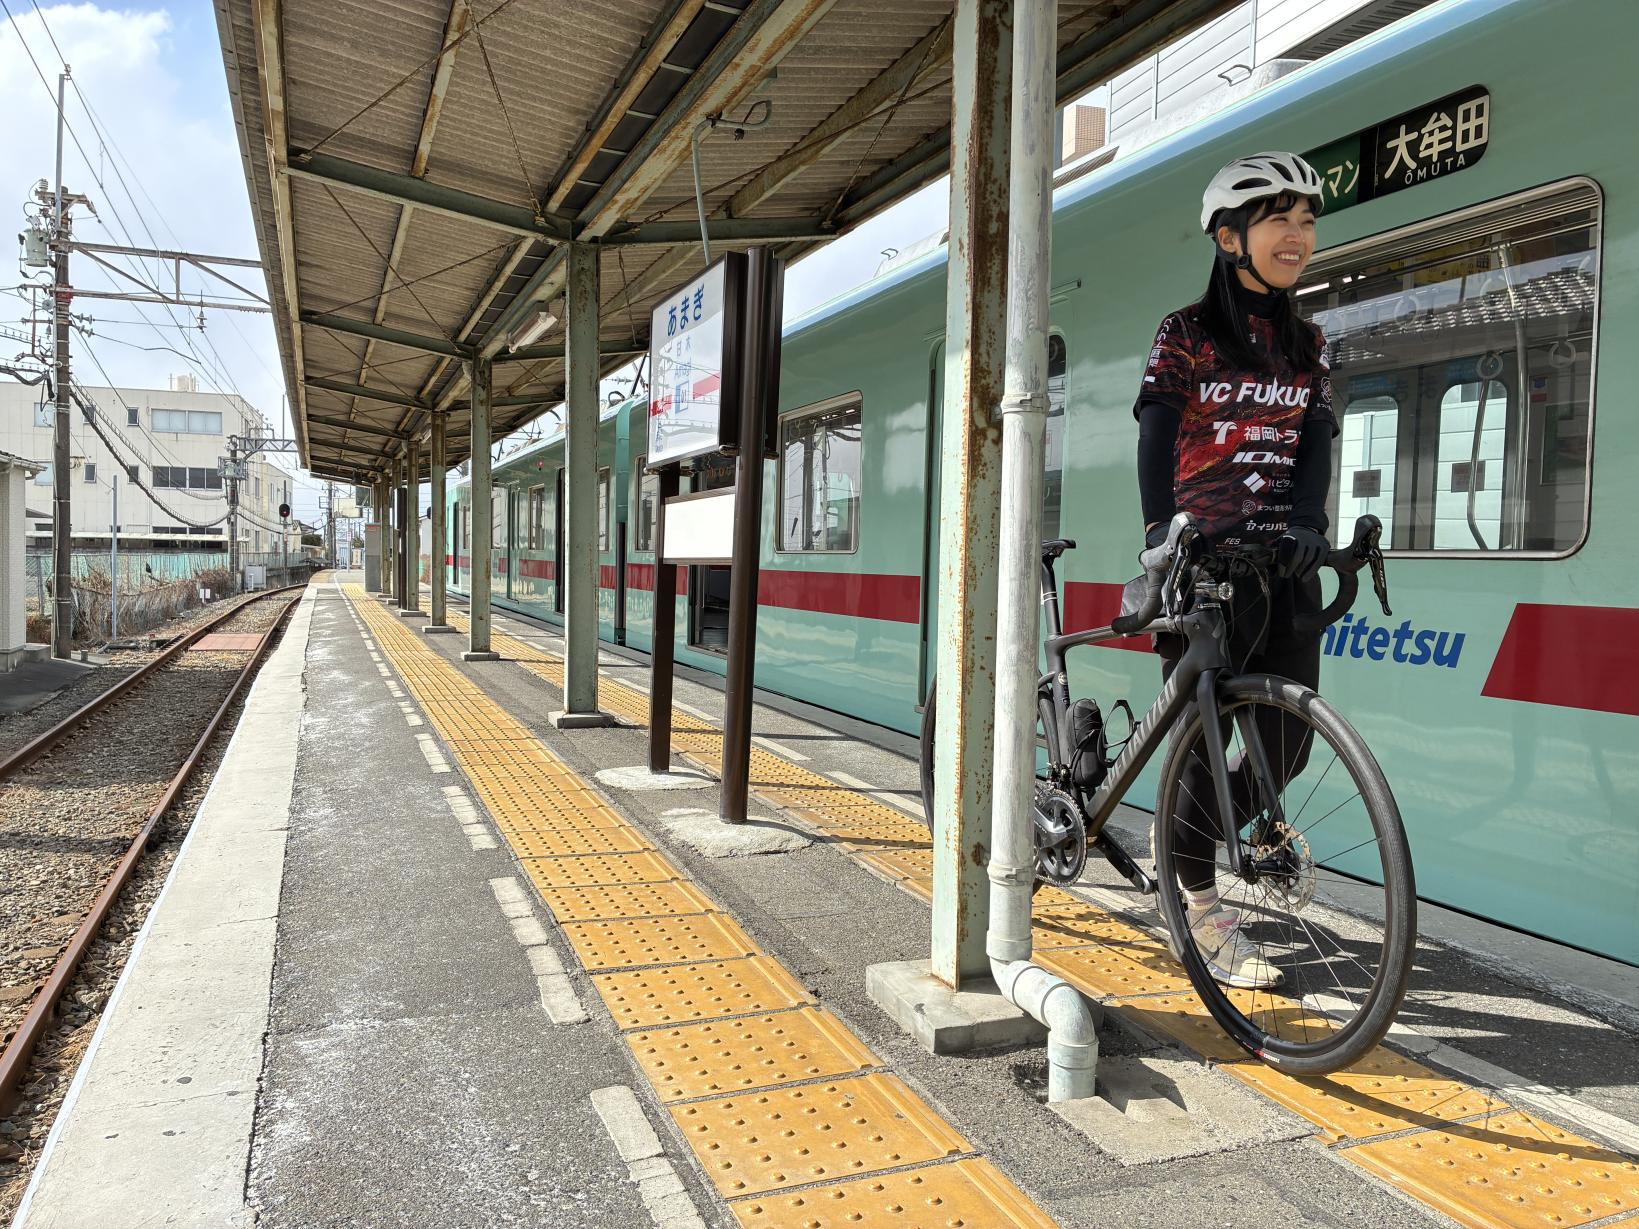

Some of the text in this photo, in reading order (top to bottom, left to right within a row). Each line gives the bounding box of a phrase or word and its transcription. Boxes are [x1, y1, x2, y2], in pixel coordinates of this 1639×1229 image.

[1384, 94, 1490, 180] 大牟田
[1320, 160, 1360, 198] マン
[667, 283, 705, 337] あまぎ
[1199, 382, 1233, 403] VC
[1243, 426, 1302, 443] 福岡トラ
